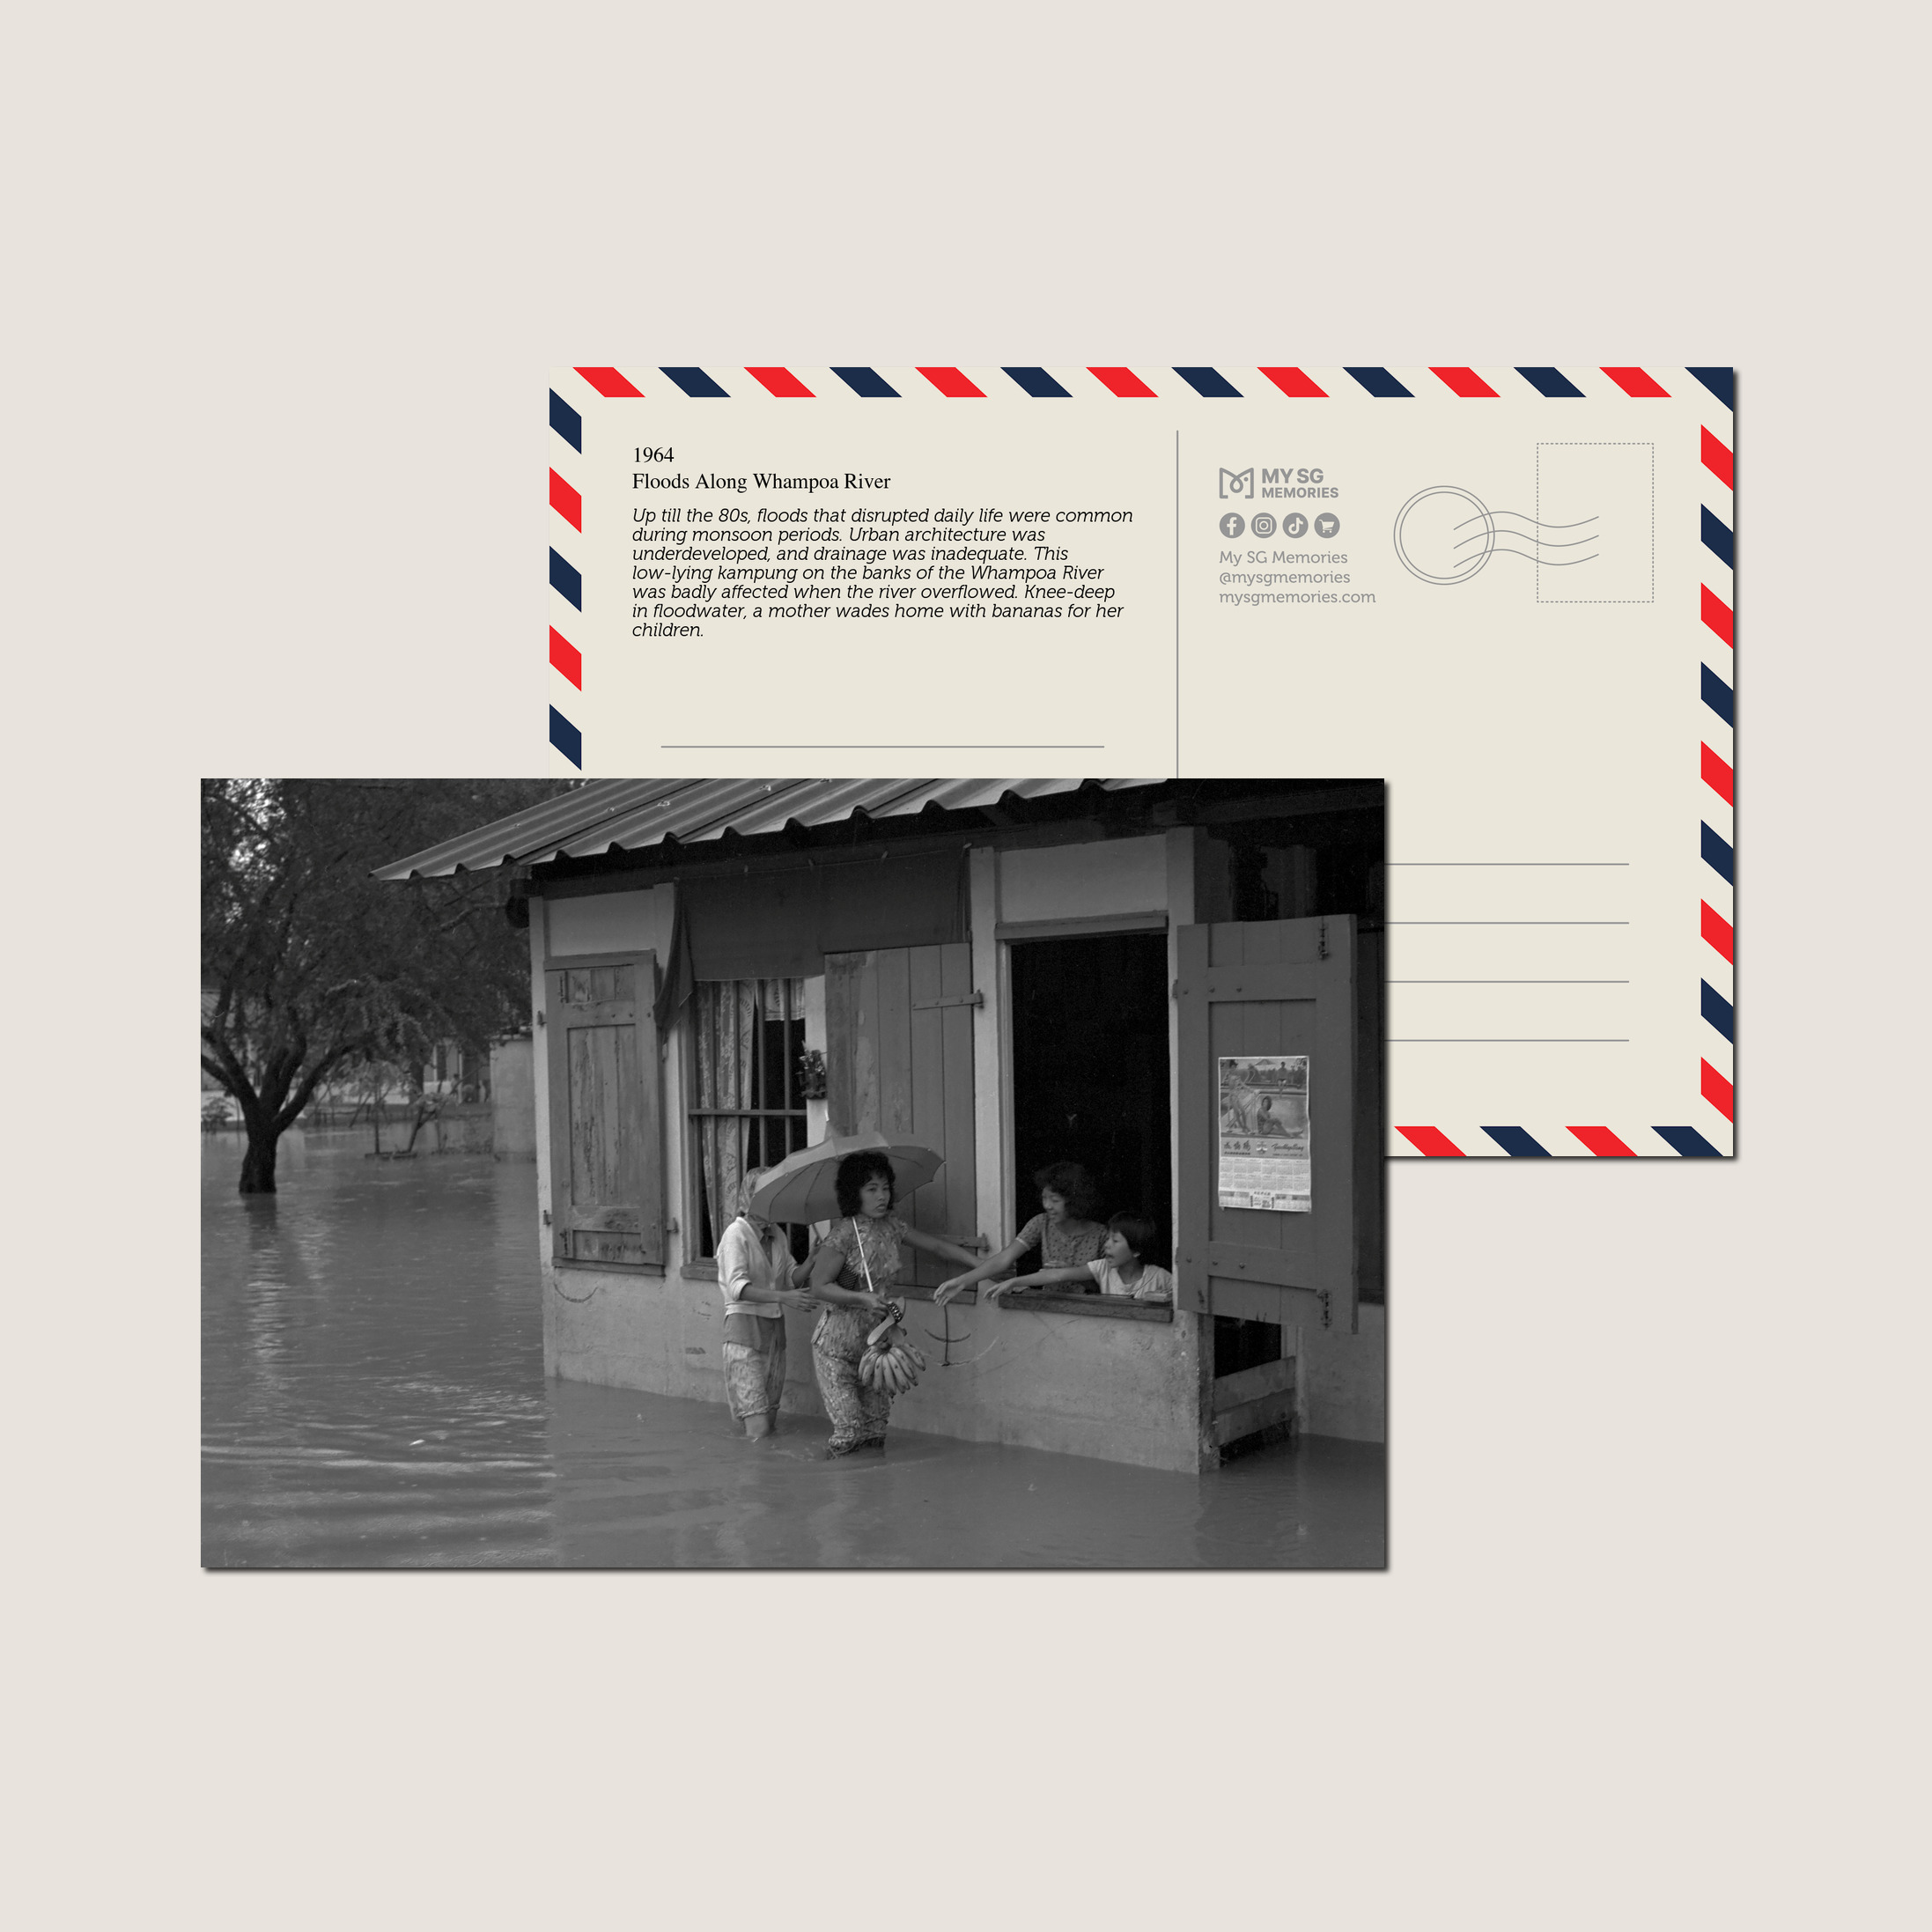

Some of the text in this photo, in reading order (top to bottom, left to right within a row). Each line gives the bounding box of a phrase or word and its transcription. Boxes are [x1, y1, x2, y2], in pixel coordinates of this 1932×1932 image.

[634, 446, 674, 462] 1964
[632, 473, 890, 493] Floods Along Whampoa River
[1261, 468, 1324, 483] MY SG
[1261, 487, 1338, 498] MEMORIES
[633, 507, 1132, 526] Up till the 80s, floods that disrupted daily life were common
[631, 527, 1045, 545] during monsoon periods. Urban architecture was
[632, 546, 1068, 564] underdeveloped, and drainage was inadequate. This
[1219, 550, 1347, 566] My SG Memories
[632, 564, 1104, 583] low-lying kampung on the banks of the Whampoa River
[1219, 570, 1350, 586] @mysgmemories
[632, 584, 1115, 602] was badly affected when the river overflowed. Knee-deep
[1219, 590, 1375, 606] mysgmemories.com
[632, 603, 1124, 619] in floodwater, a mother wades home with bananas for her
[631, 622, 703, 637] children.
